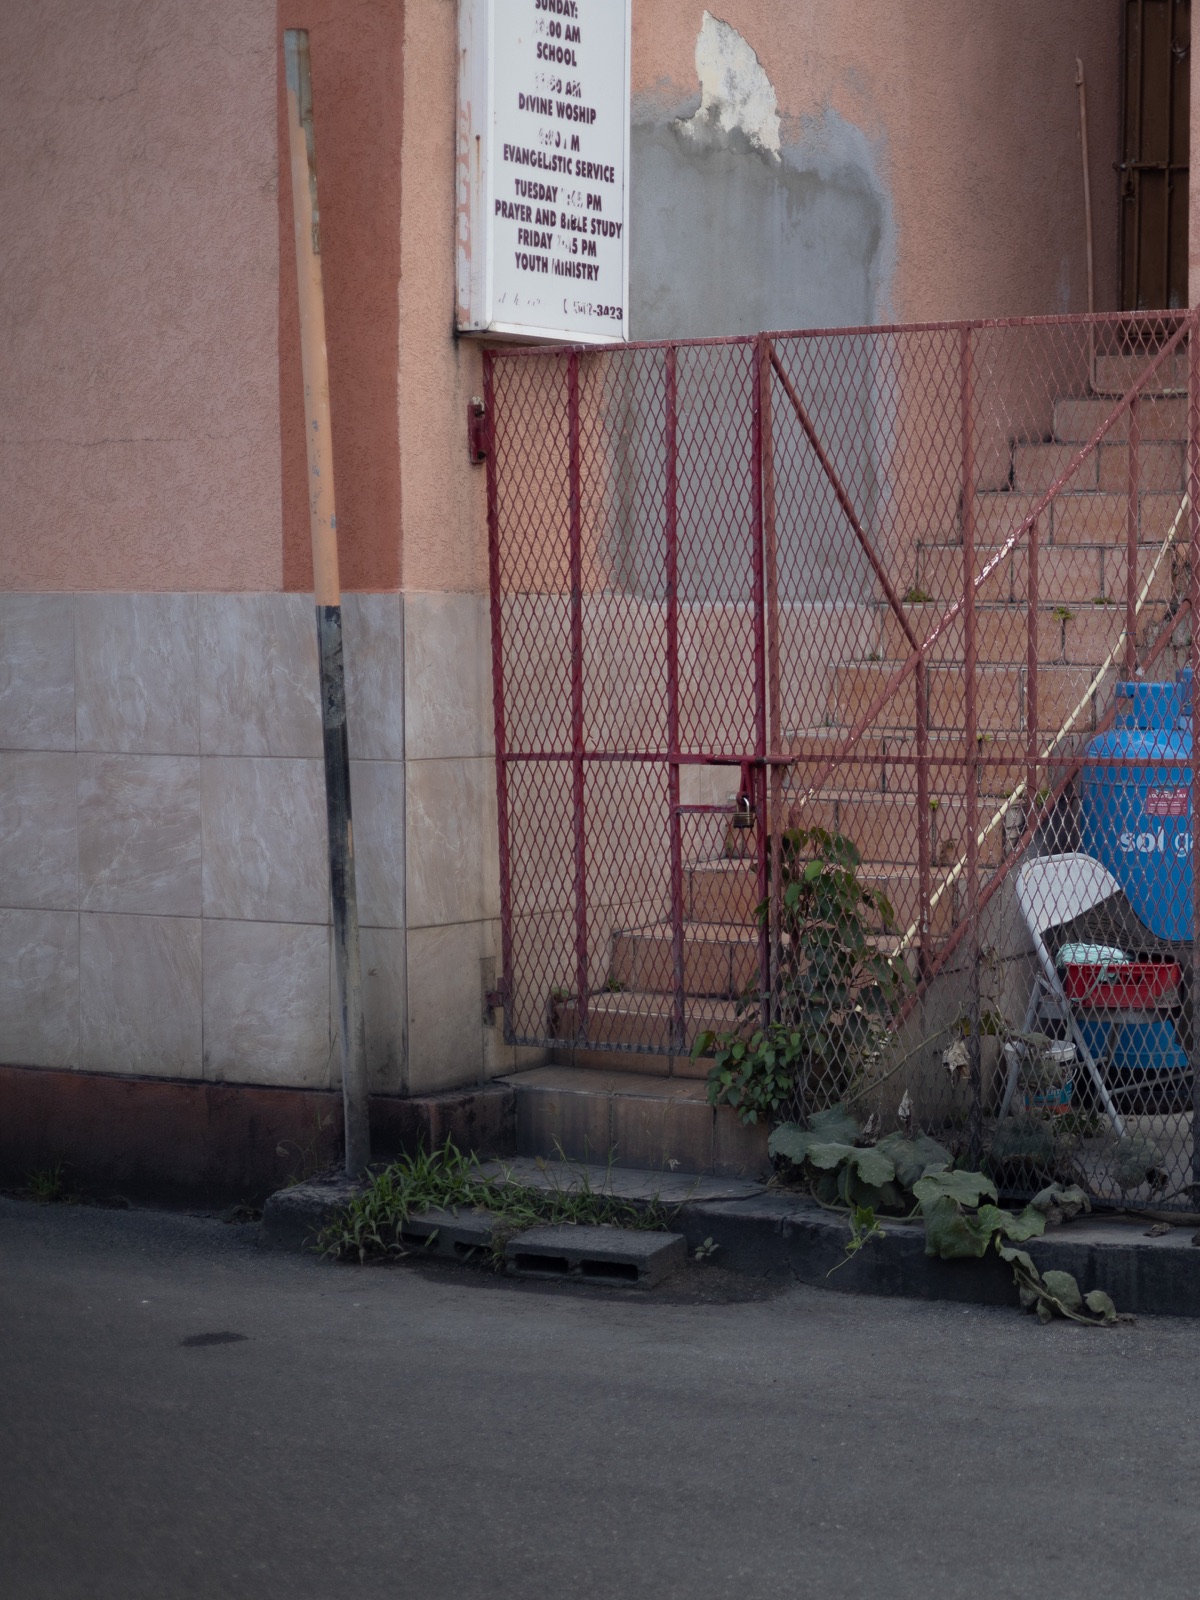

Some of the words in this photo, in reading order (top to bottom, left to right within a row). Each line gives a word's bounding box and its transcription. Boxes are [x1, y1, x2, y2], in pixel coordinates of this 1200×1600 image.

[565, 24, 581, 44] AM
[536, 41, 577, 67] SCHOOL
[518, 92, 553, 116] DIVINE
[556, 100, 597, 125] WOSHIP
[503, 143, 572, 175] EVANGELISTIC
[575, 159, 615, 184] SERVICE
[514, 178, 559, 203] TUESDAY
[586, 193, 602, 212] PM
[494, 199, 532, 223] PRAYER
[535, 207, 557, 227] AND
[560, 212, 588, 233] BIBLE
[590, 217, 623, 239] STUDY
[517, 227, 553, 250] FRIDAY
[581, 238, 597, 257] PM
[514, 252, 549, 274] YOUTH
[551, 258, 600, 281] MINISTRY
[1120, 826, 1165, 853] sol
